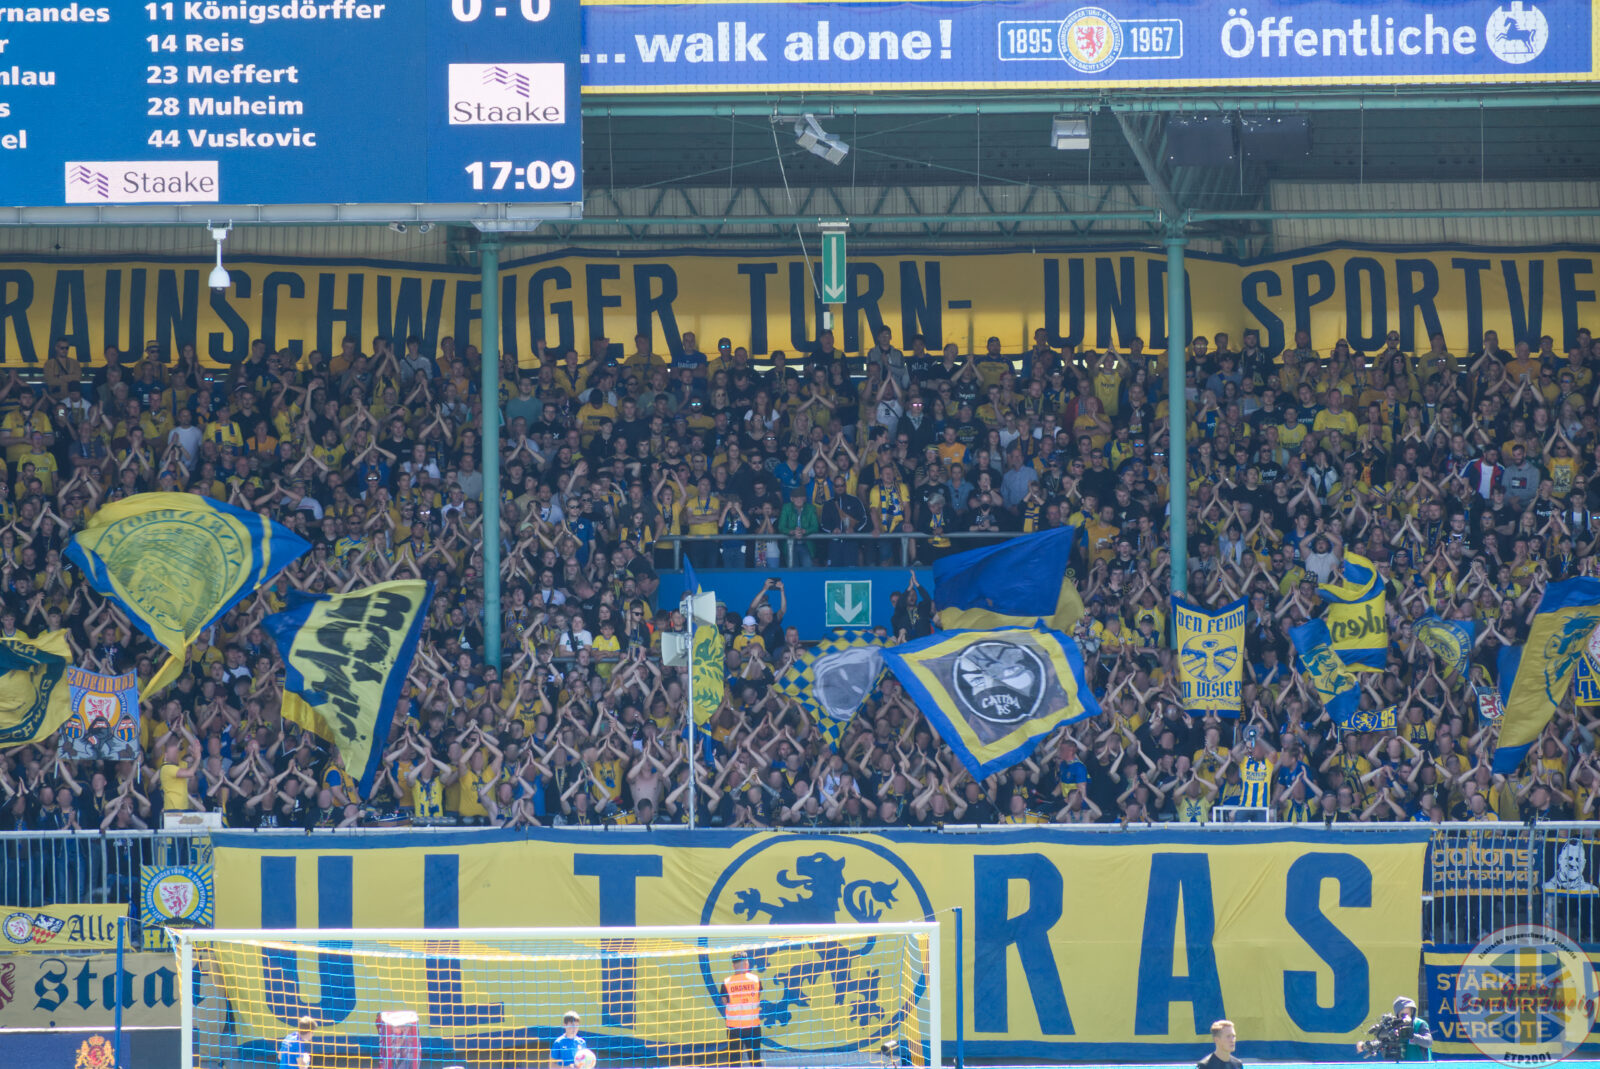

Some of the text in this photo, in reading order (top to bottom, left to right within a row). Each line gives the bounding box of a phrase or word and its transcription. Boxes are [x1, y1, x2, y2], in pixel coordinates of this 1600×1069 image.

[144, 1, 385, 23] 11 Königsdörffer
[451, 0, 482, 22] 0
[520, 0, 551, 22] 0
[146, 33, 244, 52] 14 Reis
[635, 21, 767, 63] walk
[784, 19, 953, 62] alone!
[1007, 27, 1053, 55] 1895
[1128, 25, 1173, 53] 1967
[1220, 8, 1477, 59] Öffentliche
[146, 65, 299, 84] 23 Meffert
[147, 96, 304, 116] 28 Muheim
[453, 101, 560, 123] Staake
[147, 128, 317, 148] 44 Vuskovic
[122, 170, 215, 194] Staake
[464, 160, 576, 190] 17:09
[1043, 257, 1194, 350] UND
[1436, 969, 1546, 992] STÄRKER
[1438, 997, 1552, 1015] ALS EURE
[1438, 1021, 1553, 1039] VERBOTE
